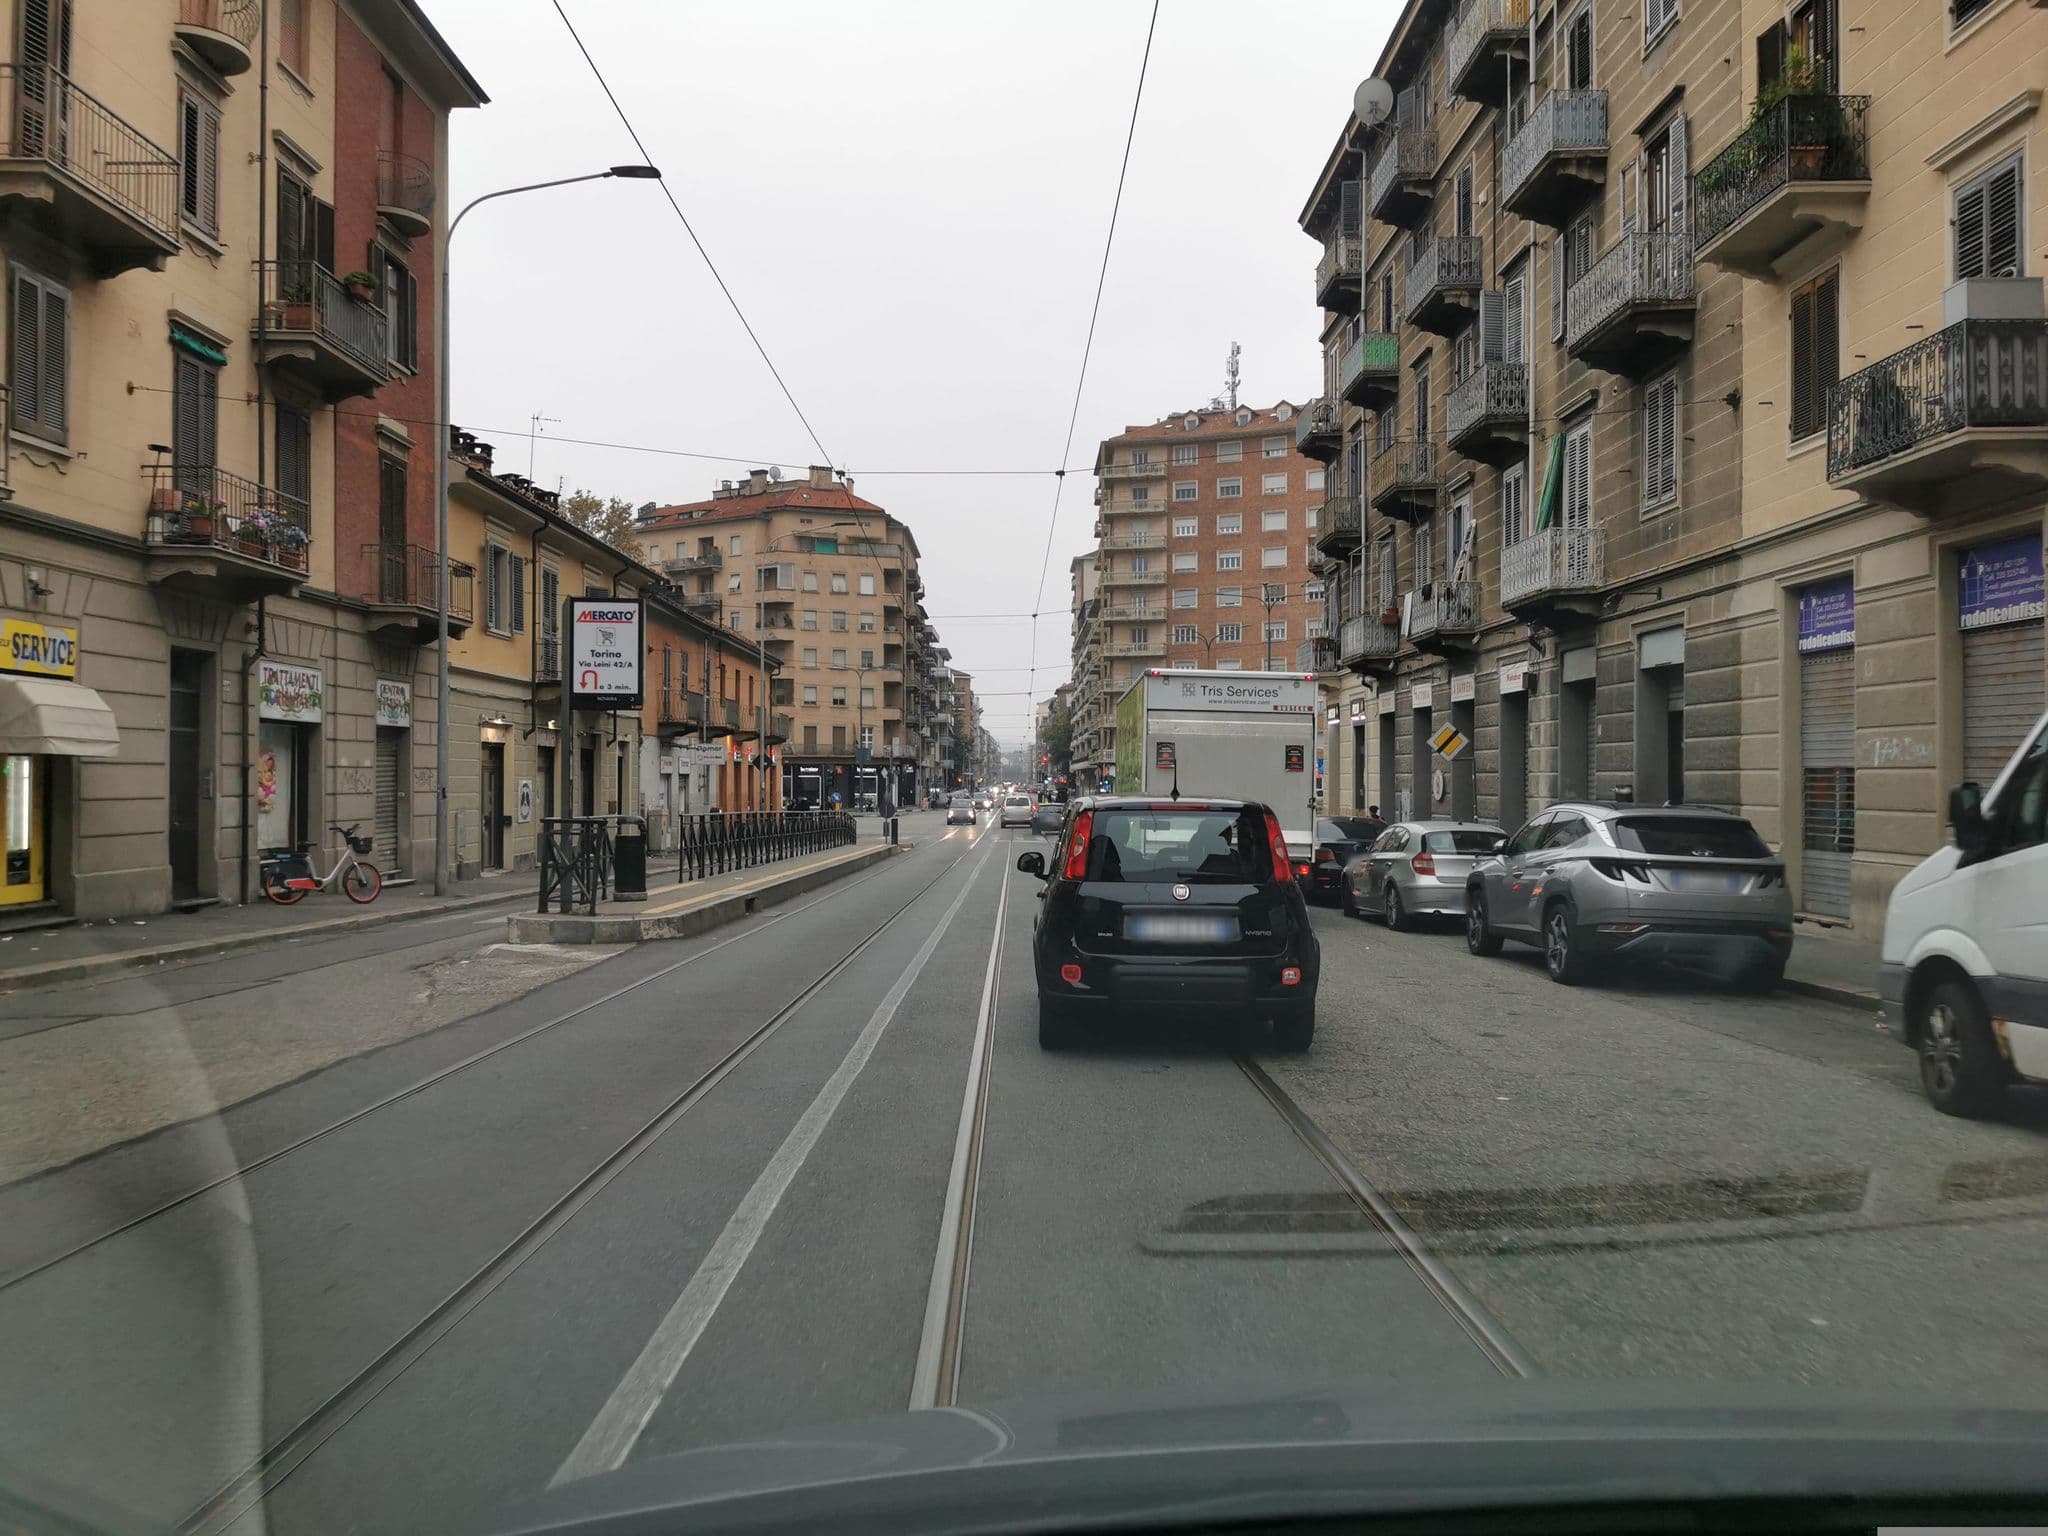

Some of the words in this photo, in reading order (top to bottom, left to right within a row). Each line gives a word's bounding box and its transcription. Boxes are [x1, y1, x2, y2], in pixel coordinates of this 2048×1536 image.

[12, 632, 76, 666] SERVICE
[590, 649, 622, 659] Torino
[578, 660, 591, 668] Via
[613, 660, 633, 669] 42/A
[263, 666, 320, 692] TRATTAMENTI
[1200, 685, 1223, 697] Tris
[1226, 685, 1279, 698] Services
